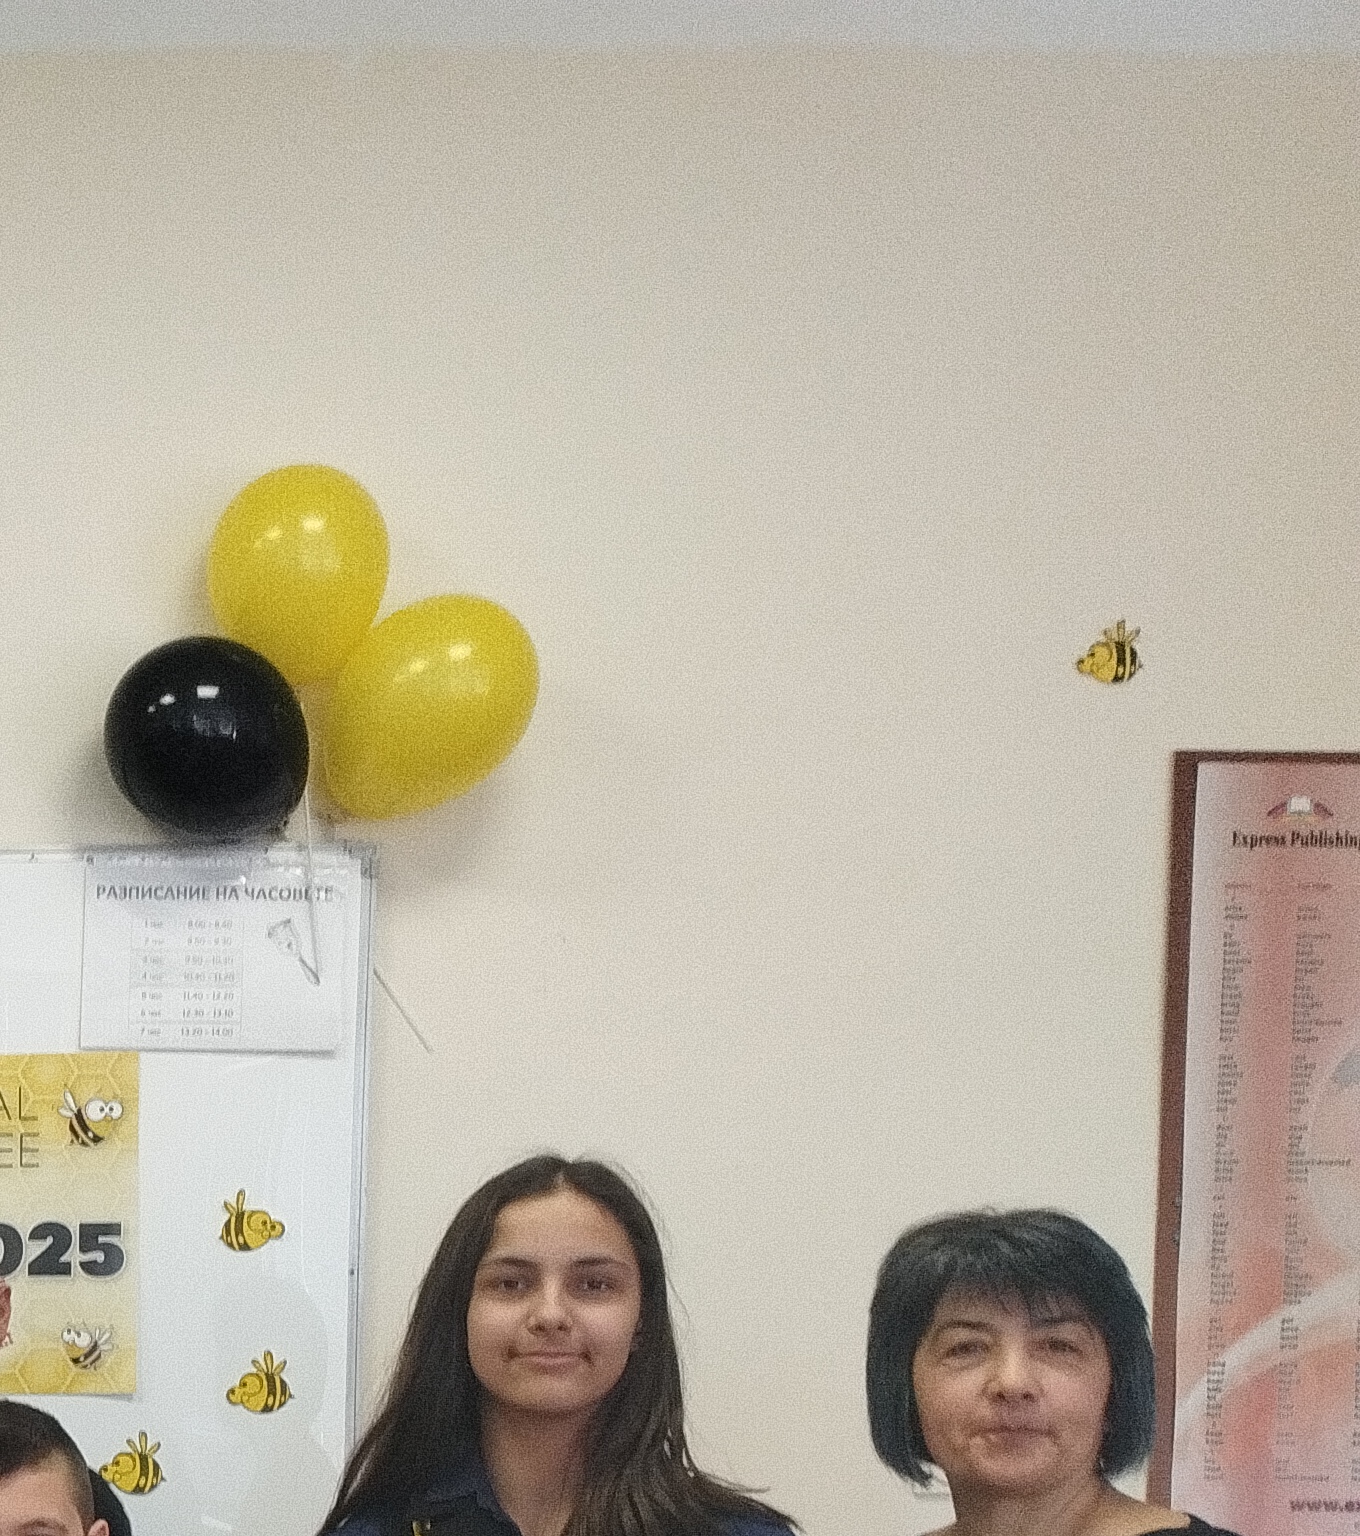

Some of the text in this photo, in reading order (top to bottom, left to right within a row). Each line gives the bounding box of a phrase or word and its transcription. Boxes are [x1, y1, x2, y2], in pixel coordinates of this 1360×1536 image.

[1232, 829, 1360, 851] Express Publishin
[96, 884, 210, 902] РАЗПИСАНИЕ
[215, 884, 239, 901] НА
